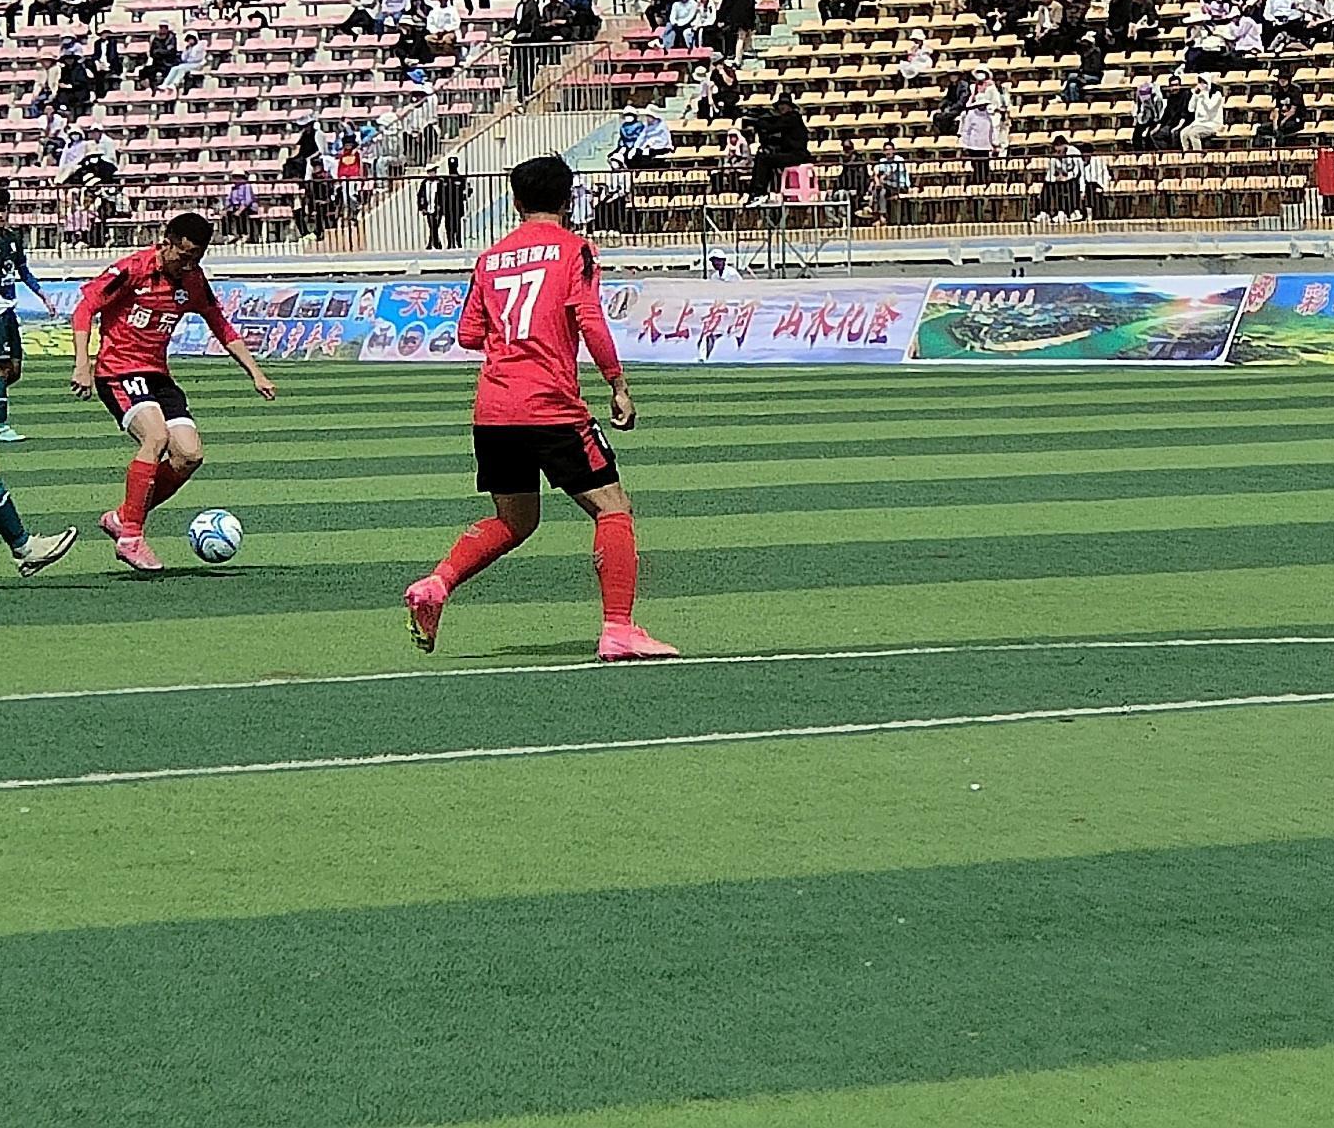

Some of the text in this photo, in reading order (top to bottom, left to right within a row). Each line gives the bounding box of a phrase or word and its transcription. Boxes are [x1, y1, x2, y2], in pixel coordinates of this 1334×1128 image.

[493, 268, 547, 345] 77
[772, 292, 902, 350] 山水化隆
[122, 376, 150, 396] 47
